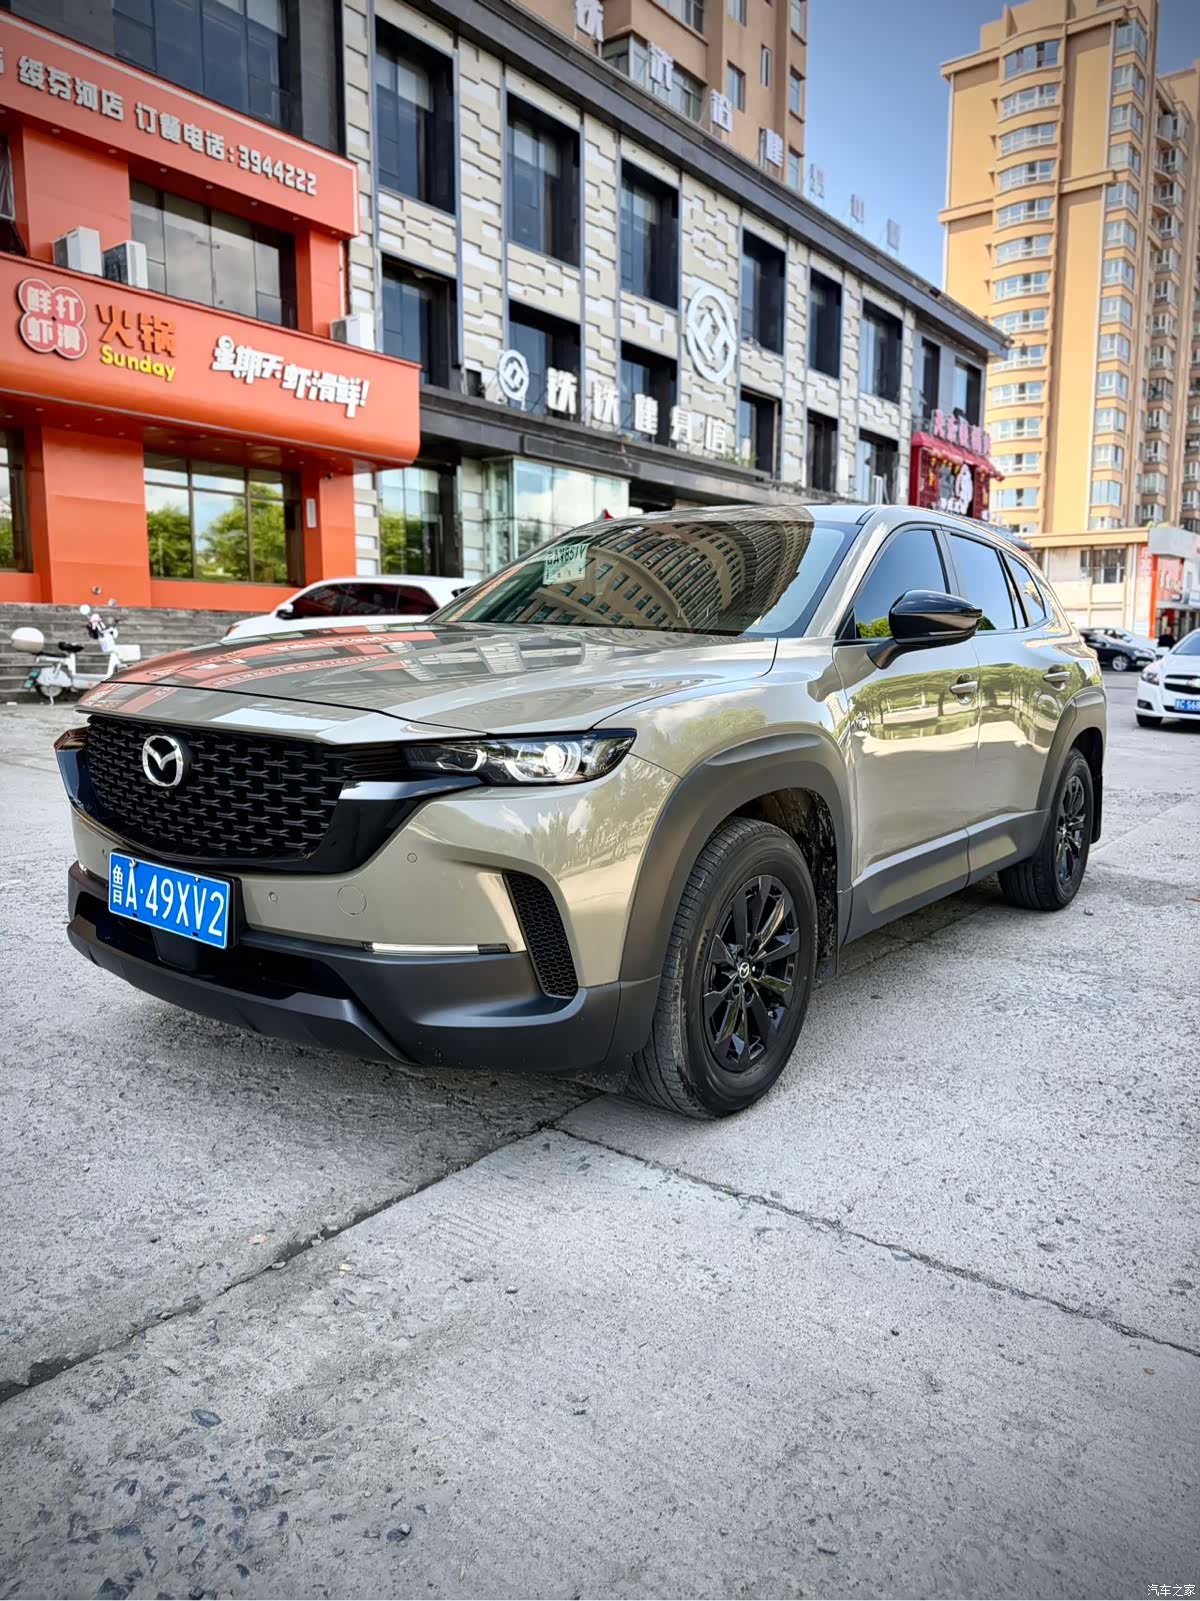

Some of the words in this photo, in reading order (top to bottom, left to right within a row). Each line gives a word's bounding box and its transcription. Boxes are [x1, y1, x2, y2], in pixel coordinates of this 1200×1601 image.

[18, 55, 124, 121] 绥芬河店
[96, 304, 177, 358] 火锅
[100, 344, 176, 382] Sunday
